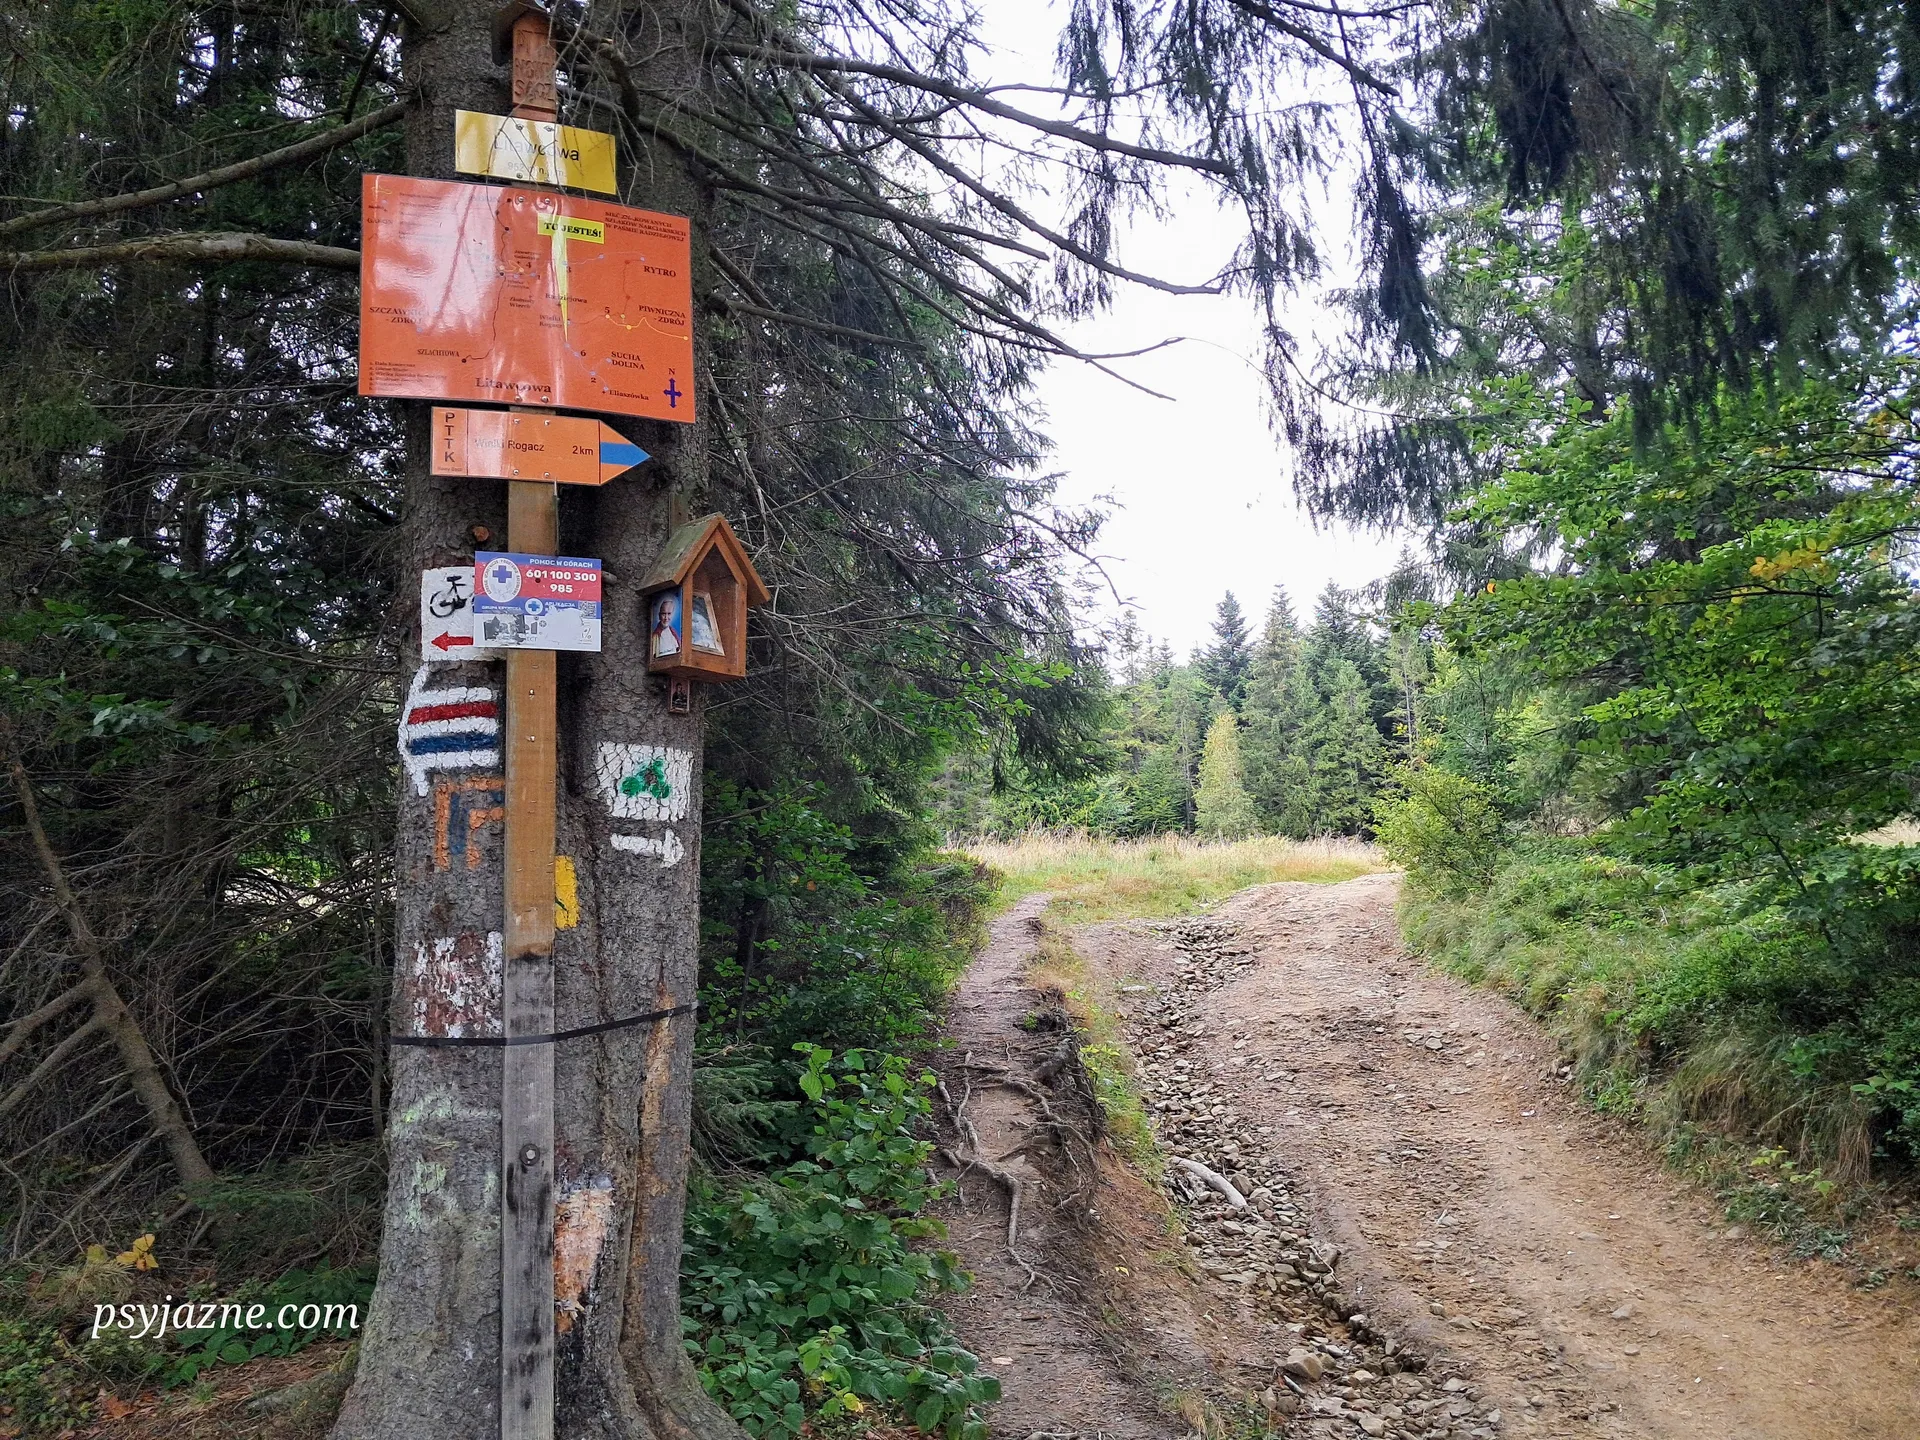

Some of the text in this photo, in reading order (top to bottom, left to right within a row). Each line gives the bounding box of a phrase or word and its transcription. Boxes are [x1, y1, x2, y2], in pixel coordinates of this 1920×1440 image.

[544, 222, 601, 238] TU JESTEŚ!
[643, 265, 676, 277] RYTRO
[605, 306, 610, 314] 5
[638, 304, 686, 319] PIWNICZNA
[580, 349, 586, 357] 6
[611, 350, 641, 361] SUCHA
[612, 359, 645, 370] DOLINA
[668, 367, 676, 375] N
[609, 389, 649, 401] Eliaszówka
[444, 412, 456, 462] PTTK
[474, 439, 505, 449] Wielki
[507, 440, 545, 452] Rogacz
[529, 558, 556, 567] POMOC
[564, 560, 593, 568] GÓRACH
[526, 569, 597, 582] 601 100 300
[549, 583, 573, 594] 985
